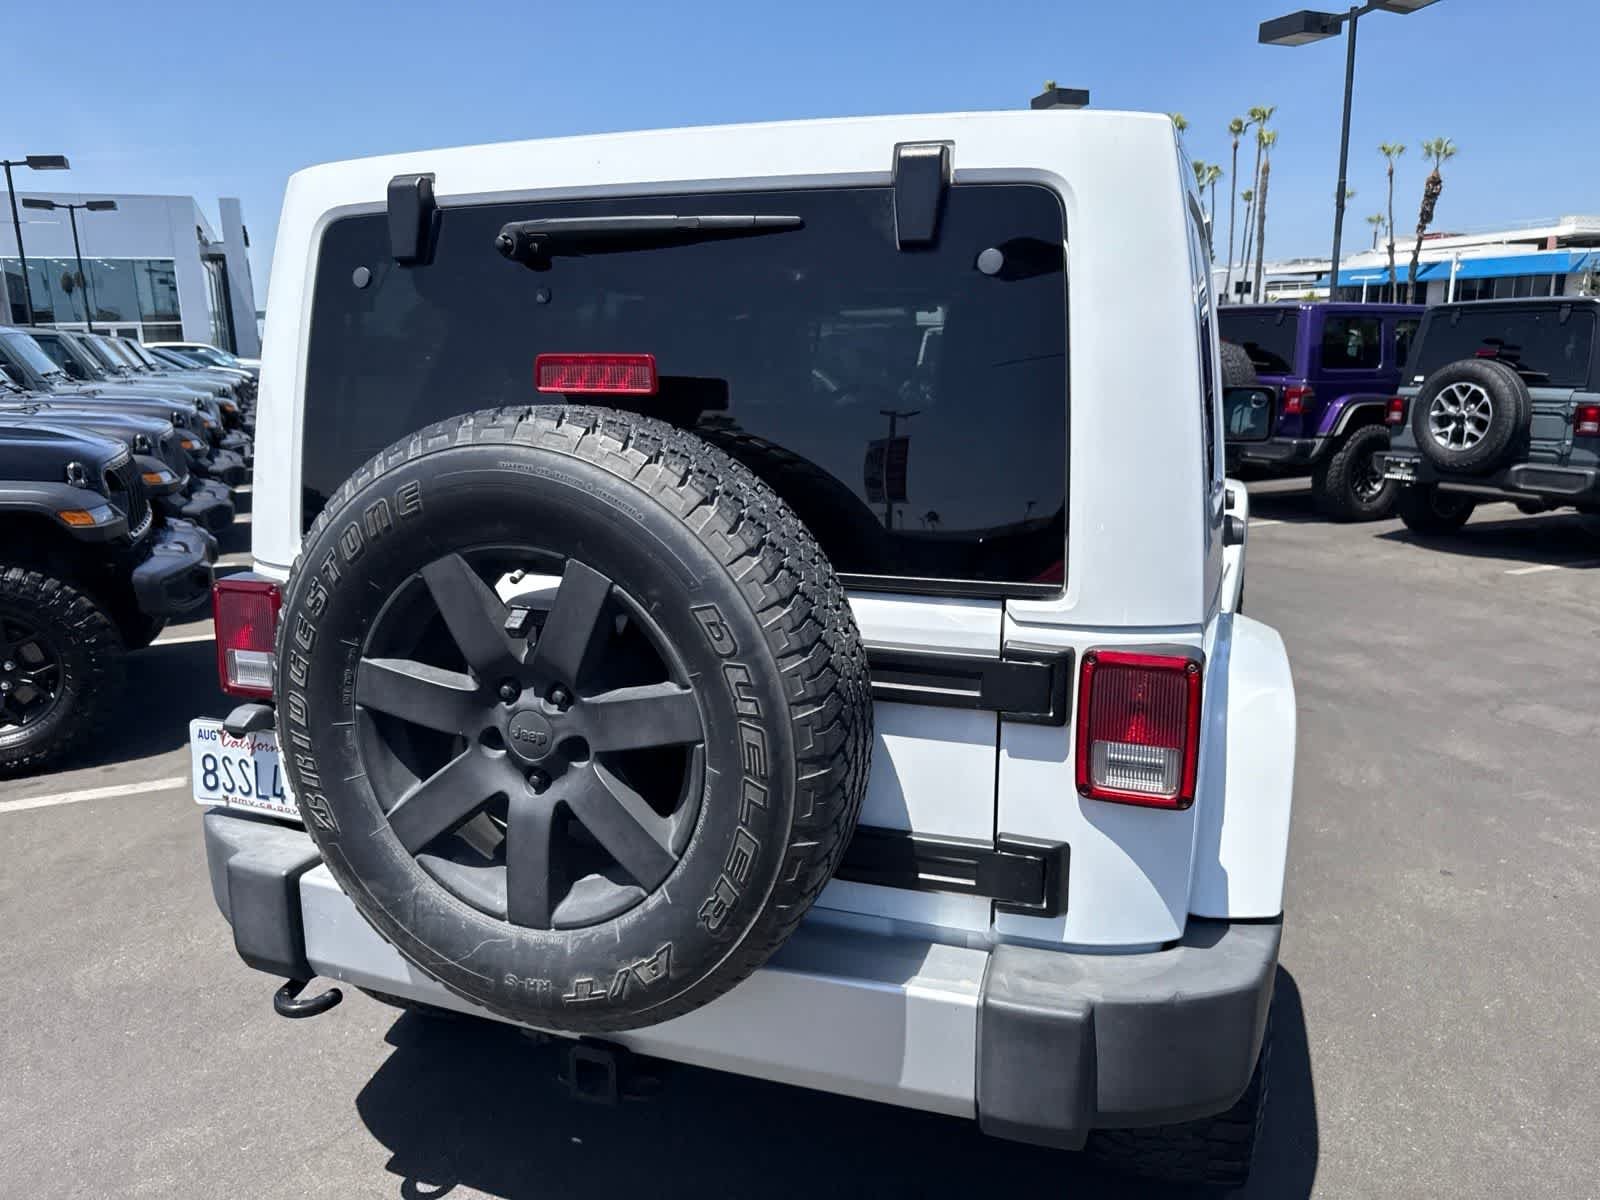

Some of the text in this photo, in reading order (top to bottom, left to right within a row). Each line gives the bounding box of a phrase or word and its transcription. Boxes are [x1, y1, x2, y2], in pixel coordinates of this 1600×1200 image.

[287, 479, 423, 835] BRIDGESTONE
[197, 728, 217, 741] AUG
[219, 729, 281, 756] Californ
[511, 725, 548, 747] Jeep
[201, 753, 286, 804] 8SSL4
[688, 602, 770, 934] DUELER
[561, 941, 673, 1004] A/T
